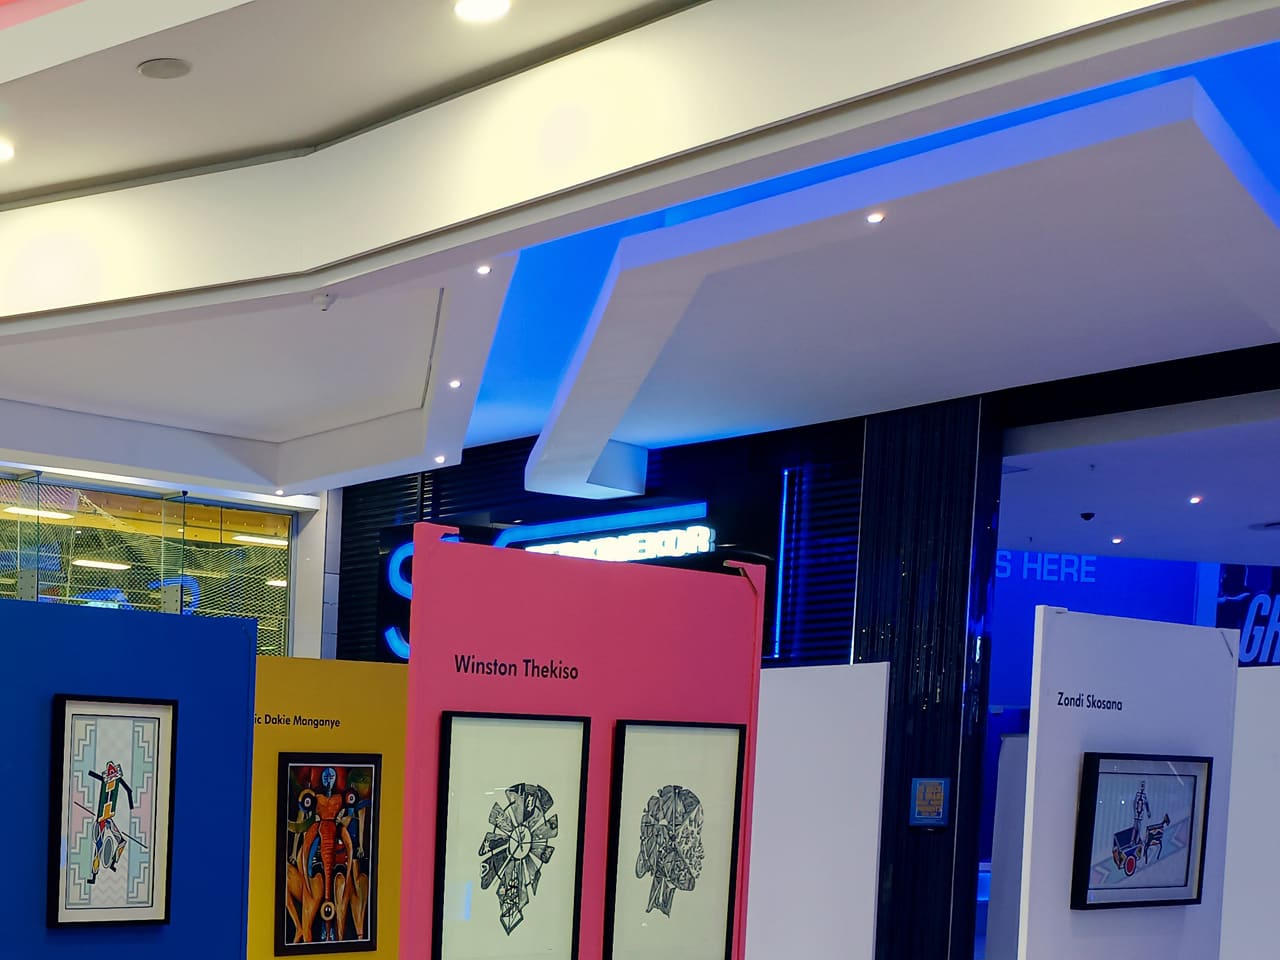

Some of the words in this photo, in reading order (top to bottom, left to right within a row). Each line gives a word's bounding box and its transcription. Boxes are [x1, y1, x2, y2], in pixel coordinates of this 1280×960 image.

[1022, 551, 1097, 583] HERE
[454, 654, 517, 677] Winston
[523, 658, 579, 680] Thekiso
[1057, 691, 1084, 708] Zondi
[1086, 694, 1123, 711] Skosana
[264, 714, 291, 725] Dakie
[293, 715, 340, 729] Manganye
